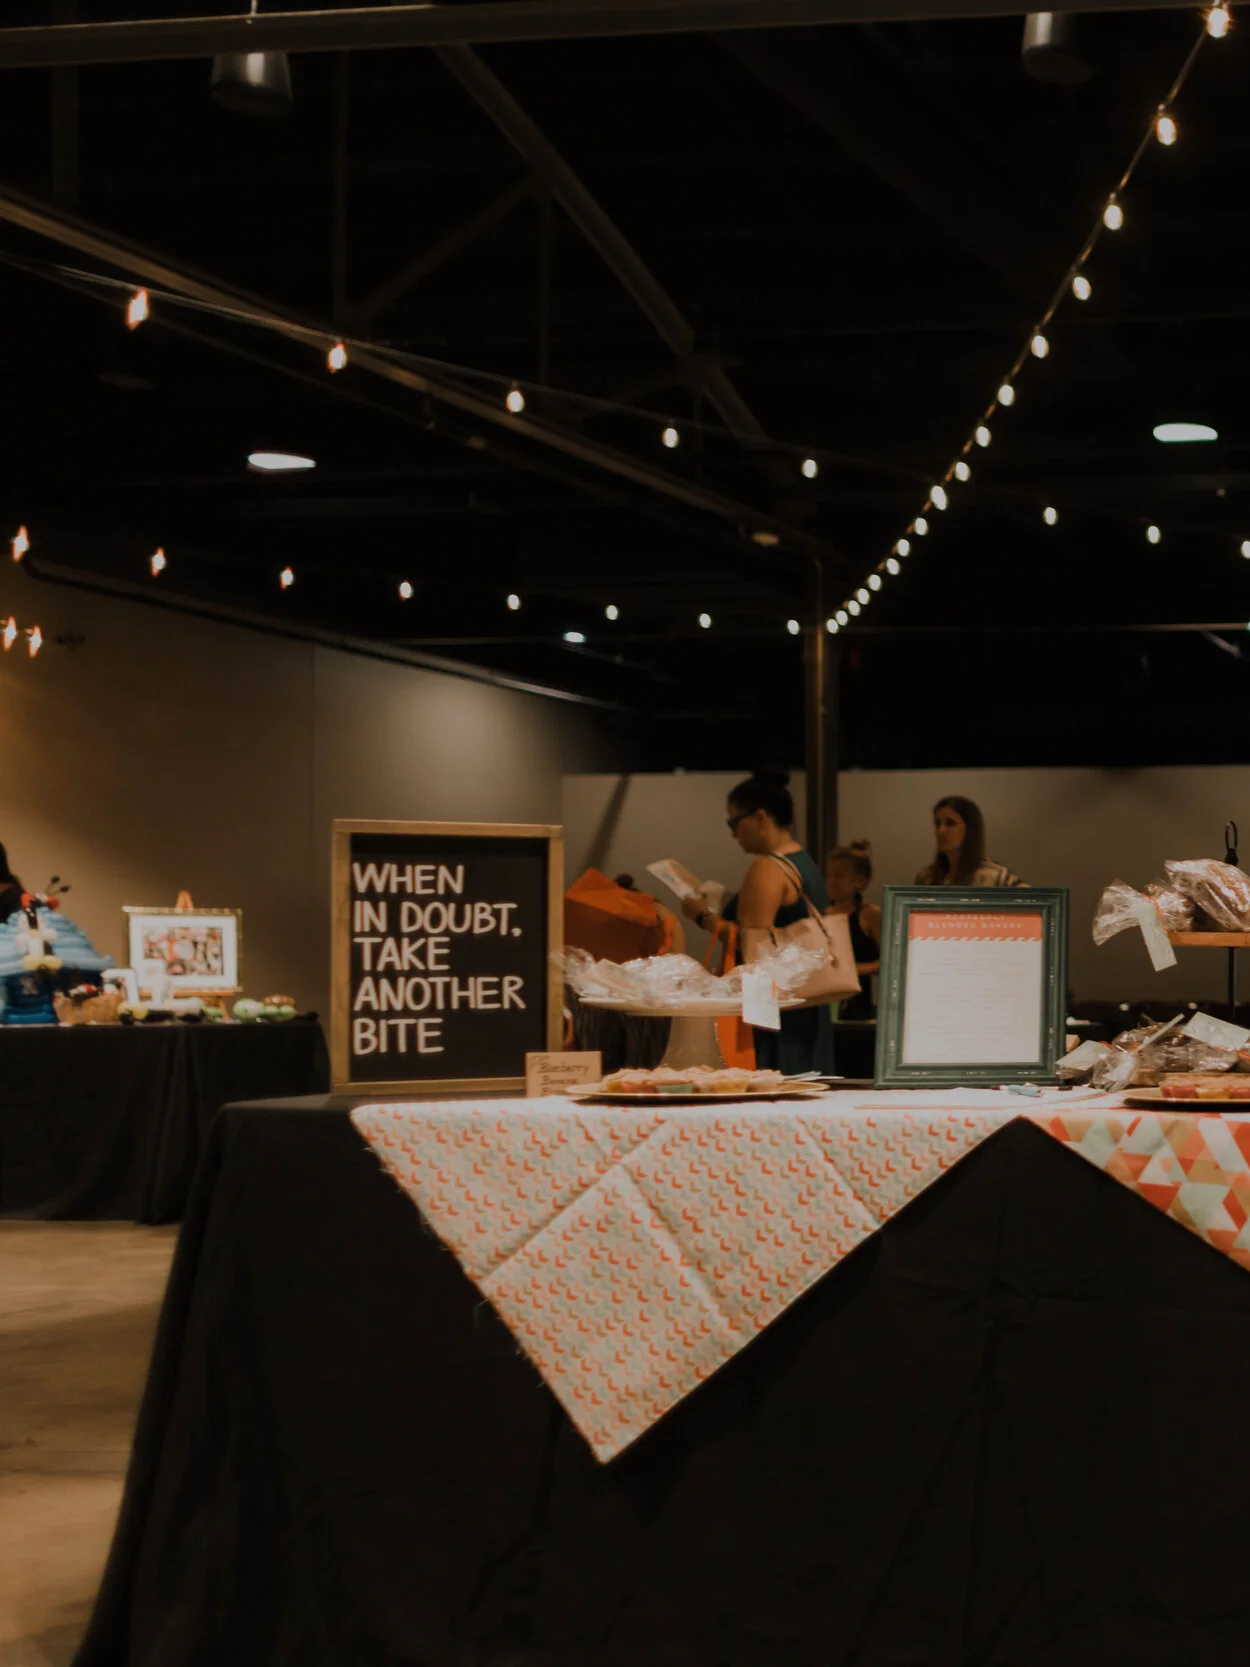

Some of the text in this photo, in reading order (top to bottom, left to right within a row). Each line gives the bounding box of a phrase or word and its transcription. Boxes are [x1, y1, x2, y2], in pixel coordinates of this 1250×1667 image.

[353, 862, 464, 895] WHEN
[354, 900, 387, 933] IN
[353, 937, 451, 972] TAKE
[353, 976, 526, 1012] ANOTHER
[353, 1017, 445, 1055] BITE
